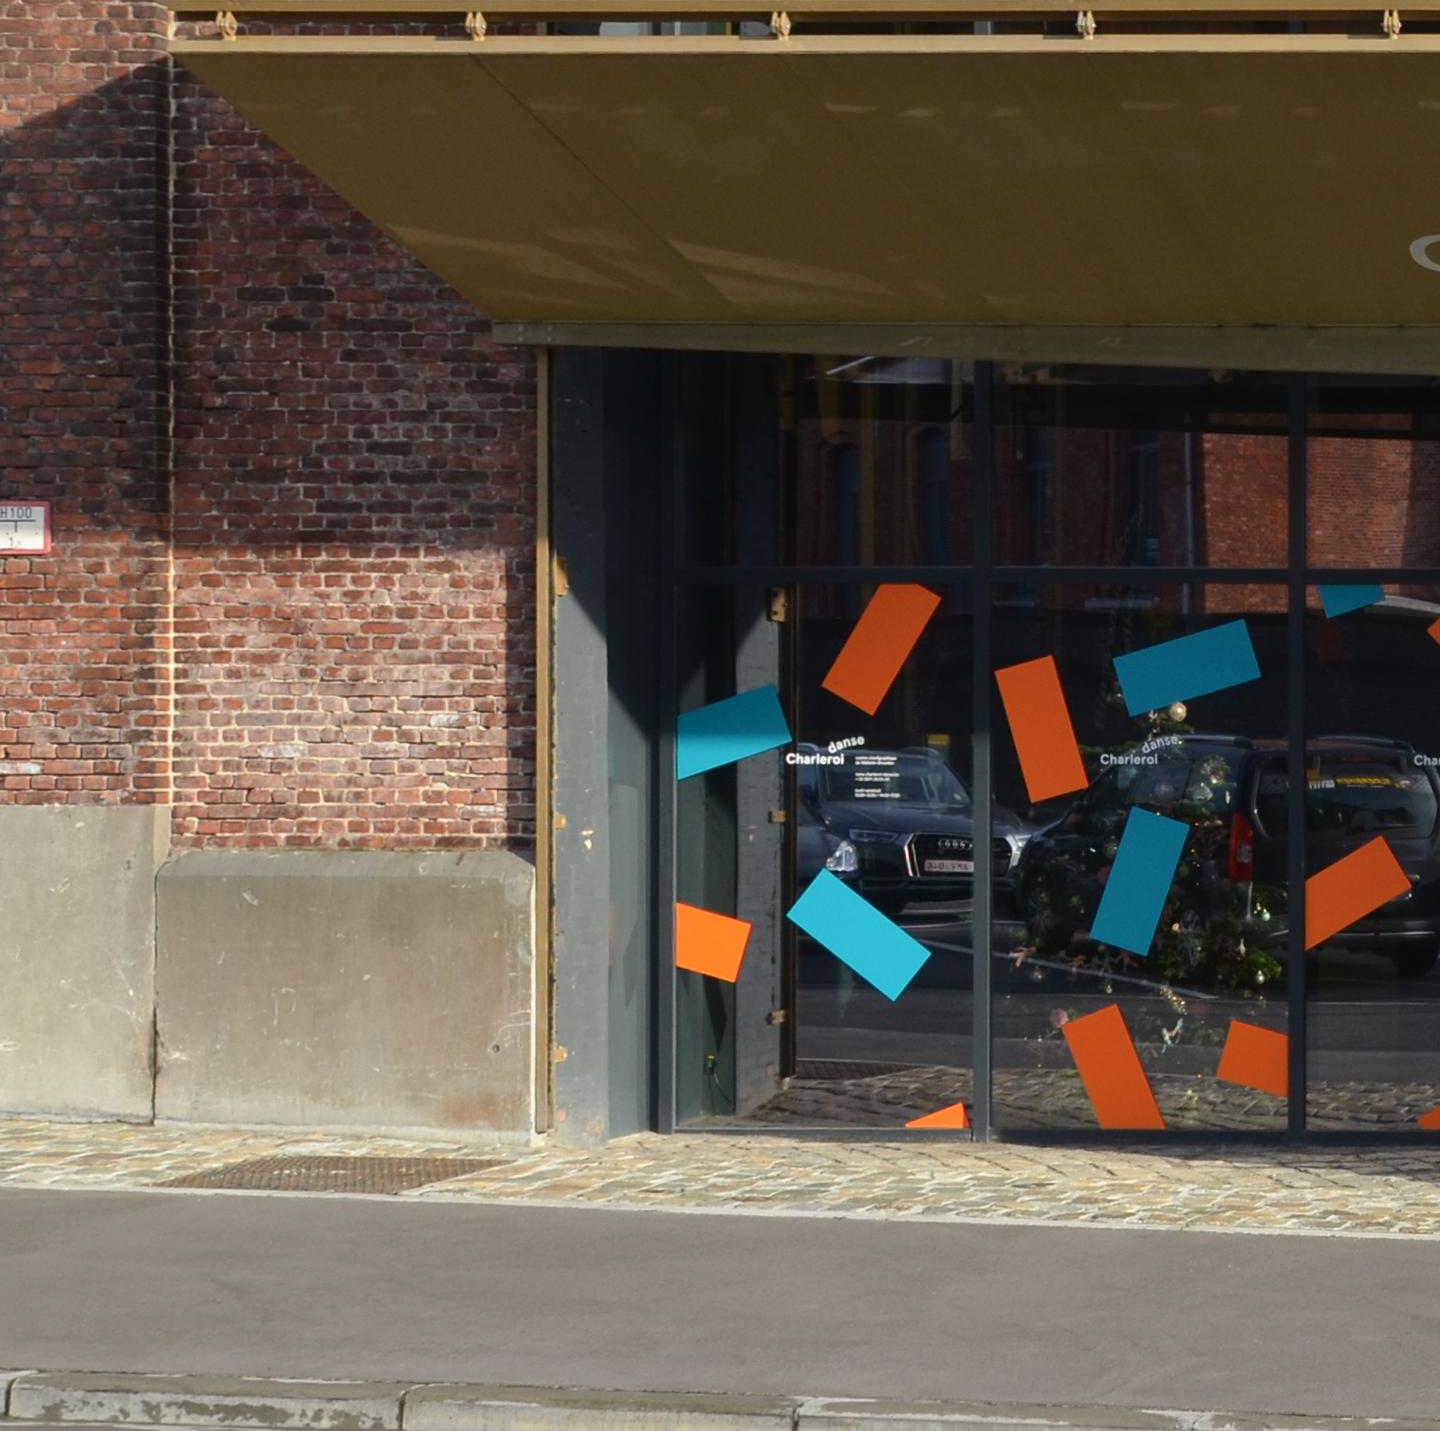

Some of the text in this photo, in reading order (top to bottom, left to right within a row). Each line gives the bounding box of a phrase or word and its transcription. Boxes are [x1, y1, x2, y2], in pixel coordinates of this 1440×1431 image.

[828, 736, 865, 754] danse
[1142, 735, 1179, 754] danse
[786, 752, 845, 765] Charleroi
[1100, 752, 1158, 766] Charleroi
